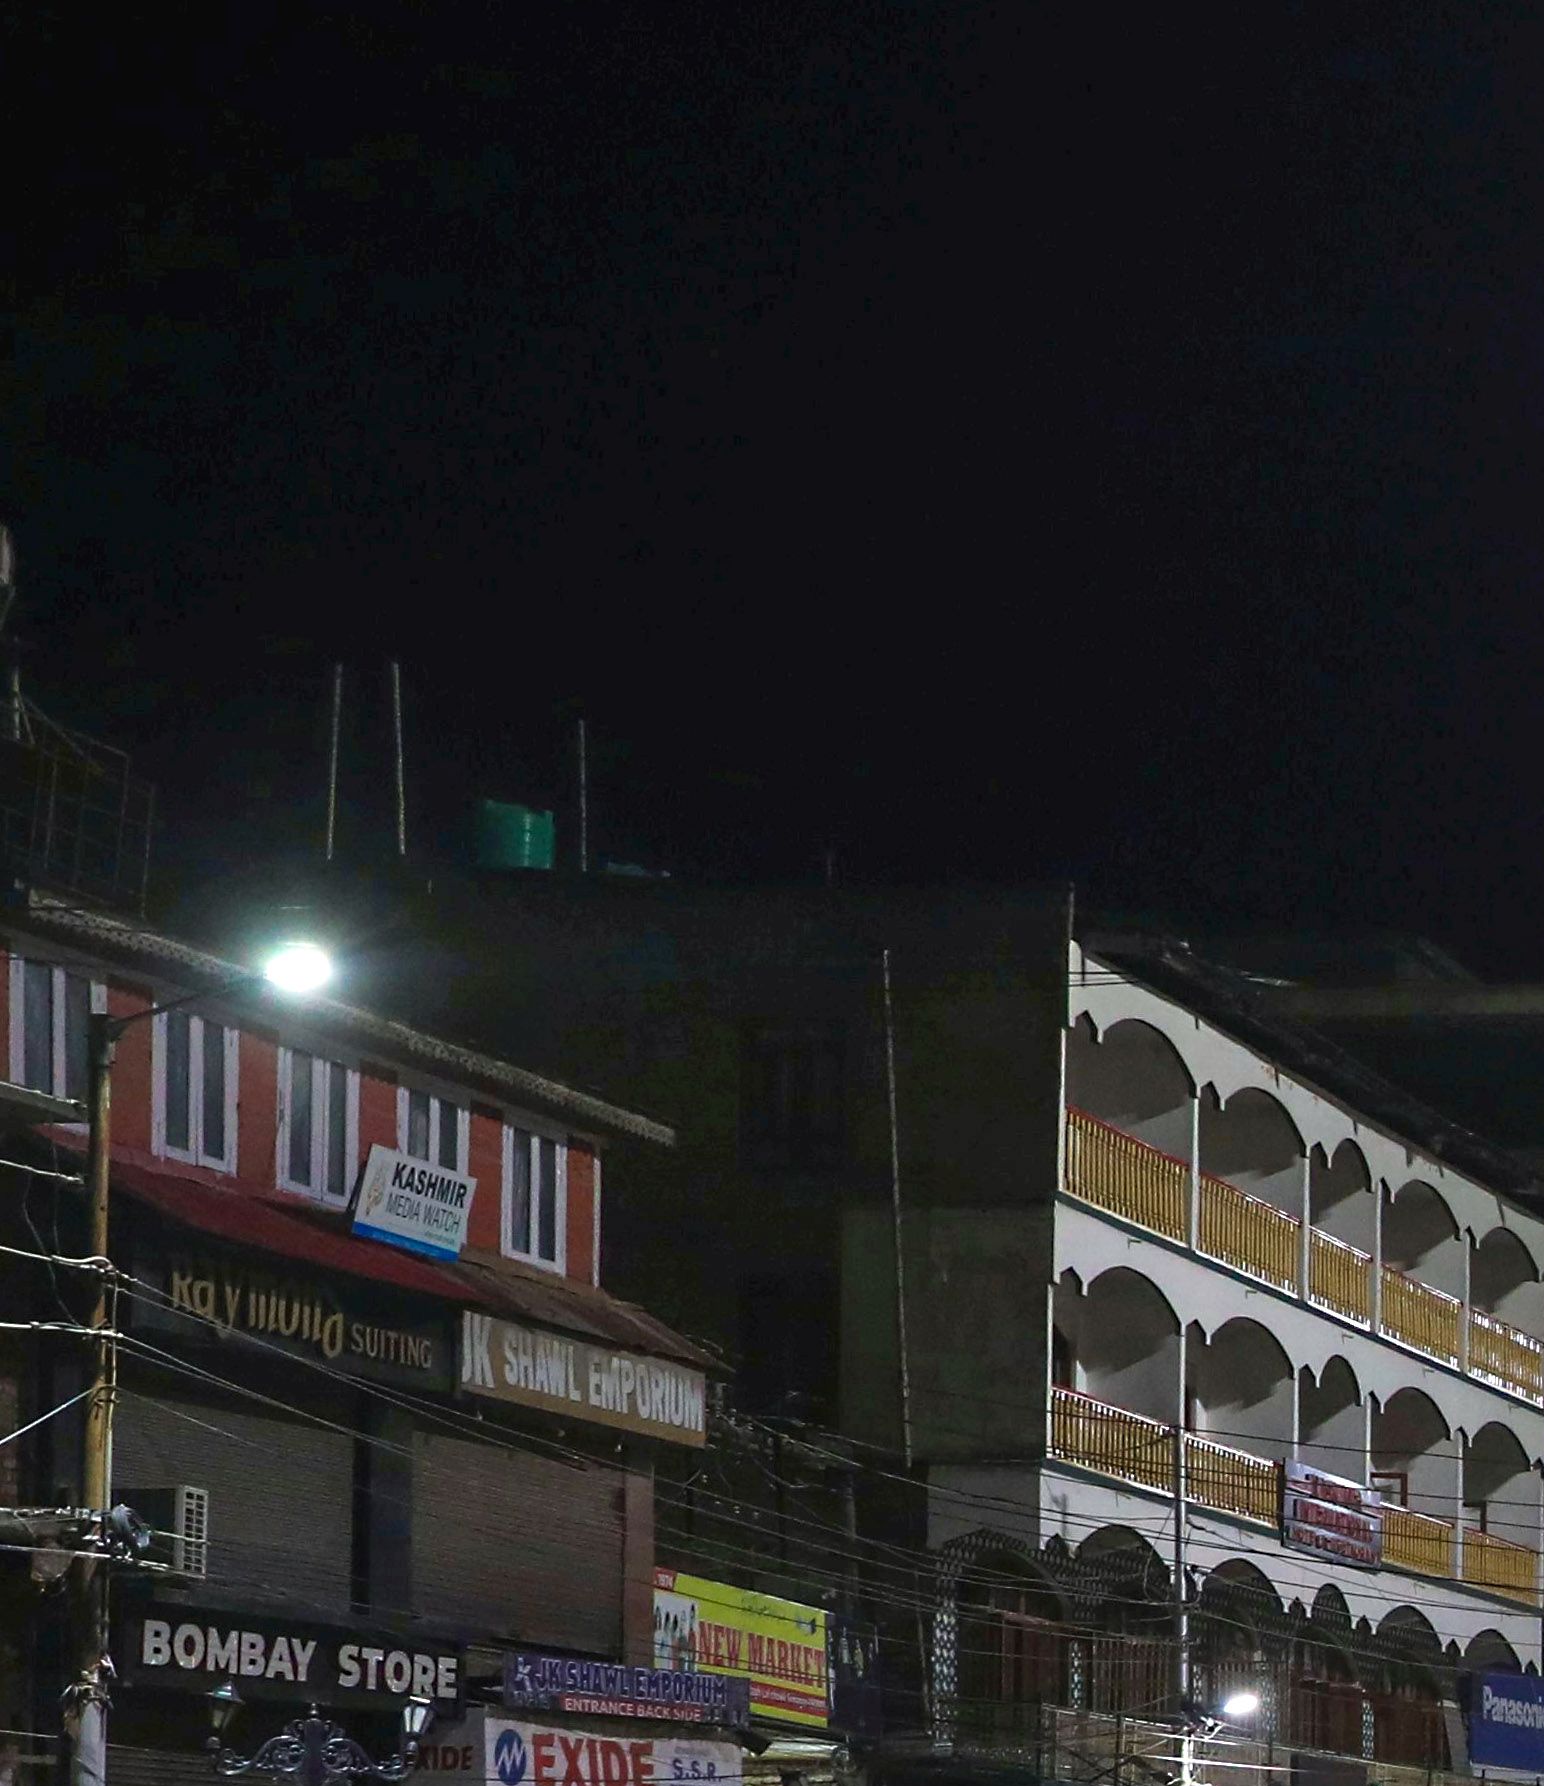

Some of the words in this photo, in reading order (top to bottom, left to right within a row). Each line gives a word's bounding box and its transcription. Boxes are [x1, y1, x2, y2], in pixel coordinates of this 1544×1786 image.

[392, 1162, 467, 1208] KASHMIR
[385, 1193, 421, 1218] MEDIA
[423, 1203, 462, 1234] WATCH
[351, 1323, 432, 1369] SUITING
[461, 1310, 494, 1388] JK
[503, 1326, 581, 1401] SHAWL
[588, 1357, 706, 1433] EMPORIUM
[143, 1618, 317, 1682] BOMBAY
[337, 1644, 458, 1699] STORE
[699, 1620, 742, 1668] NEW
[748, 1632, 826, 1689] MARKET
[565, 1661, 630, 1700] SHAWL
[632, 1667, 728, 1707] EMPORIUM
[564, 1697, 635, 1716] ENTRANCE
[636, 1702, 671, 1718] BACK
[672, 1705, 702, 1721] SIDE
[416, 1744, 474, 1771] XIDE
